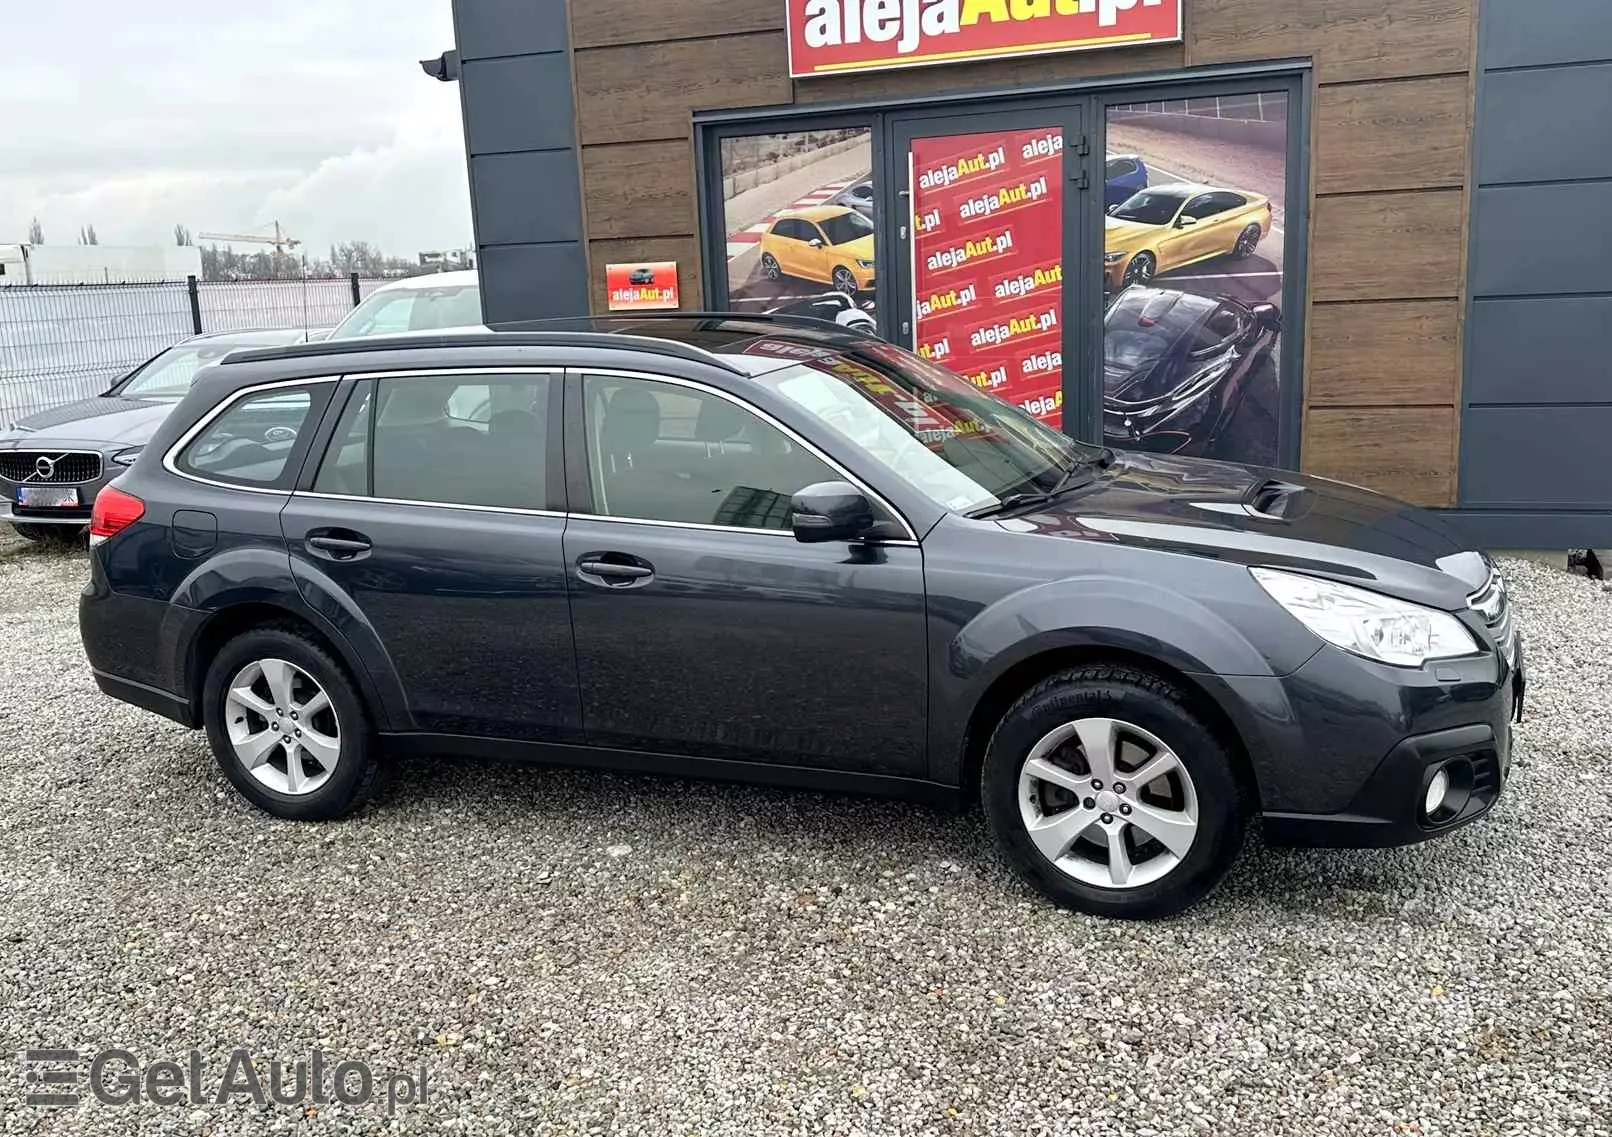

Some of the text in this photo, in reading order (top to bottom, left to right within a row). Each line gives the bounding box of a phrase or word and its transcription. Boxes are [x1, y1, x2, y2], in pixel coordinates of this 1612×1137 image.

[919, 148, 1005, 188] alejaAut.pl
[960, 177, 1047, 218] alejaAut.pl
[927, 231, 1012, 269] alejaAut.pl
[611, 286, 674, 303] alejaAut.pl
[970, 308, 1057, 347] alejaAut.pl
